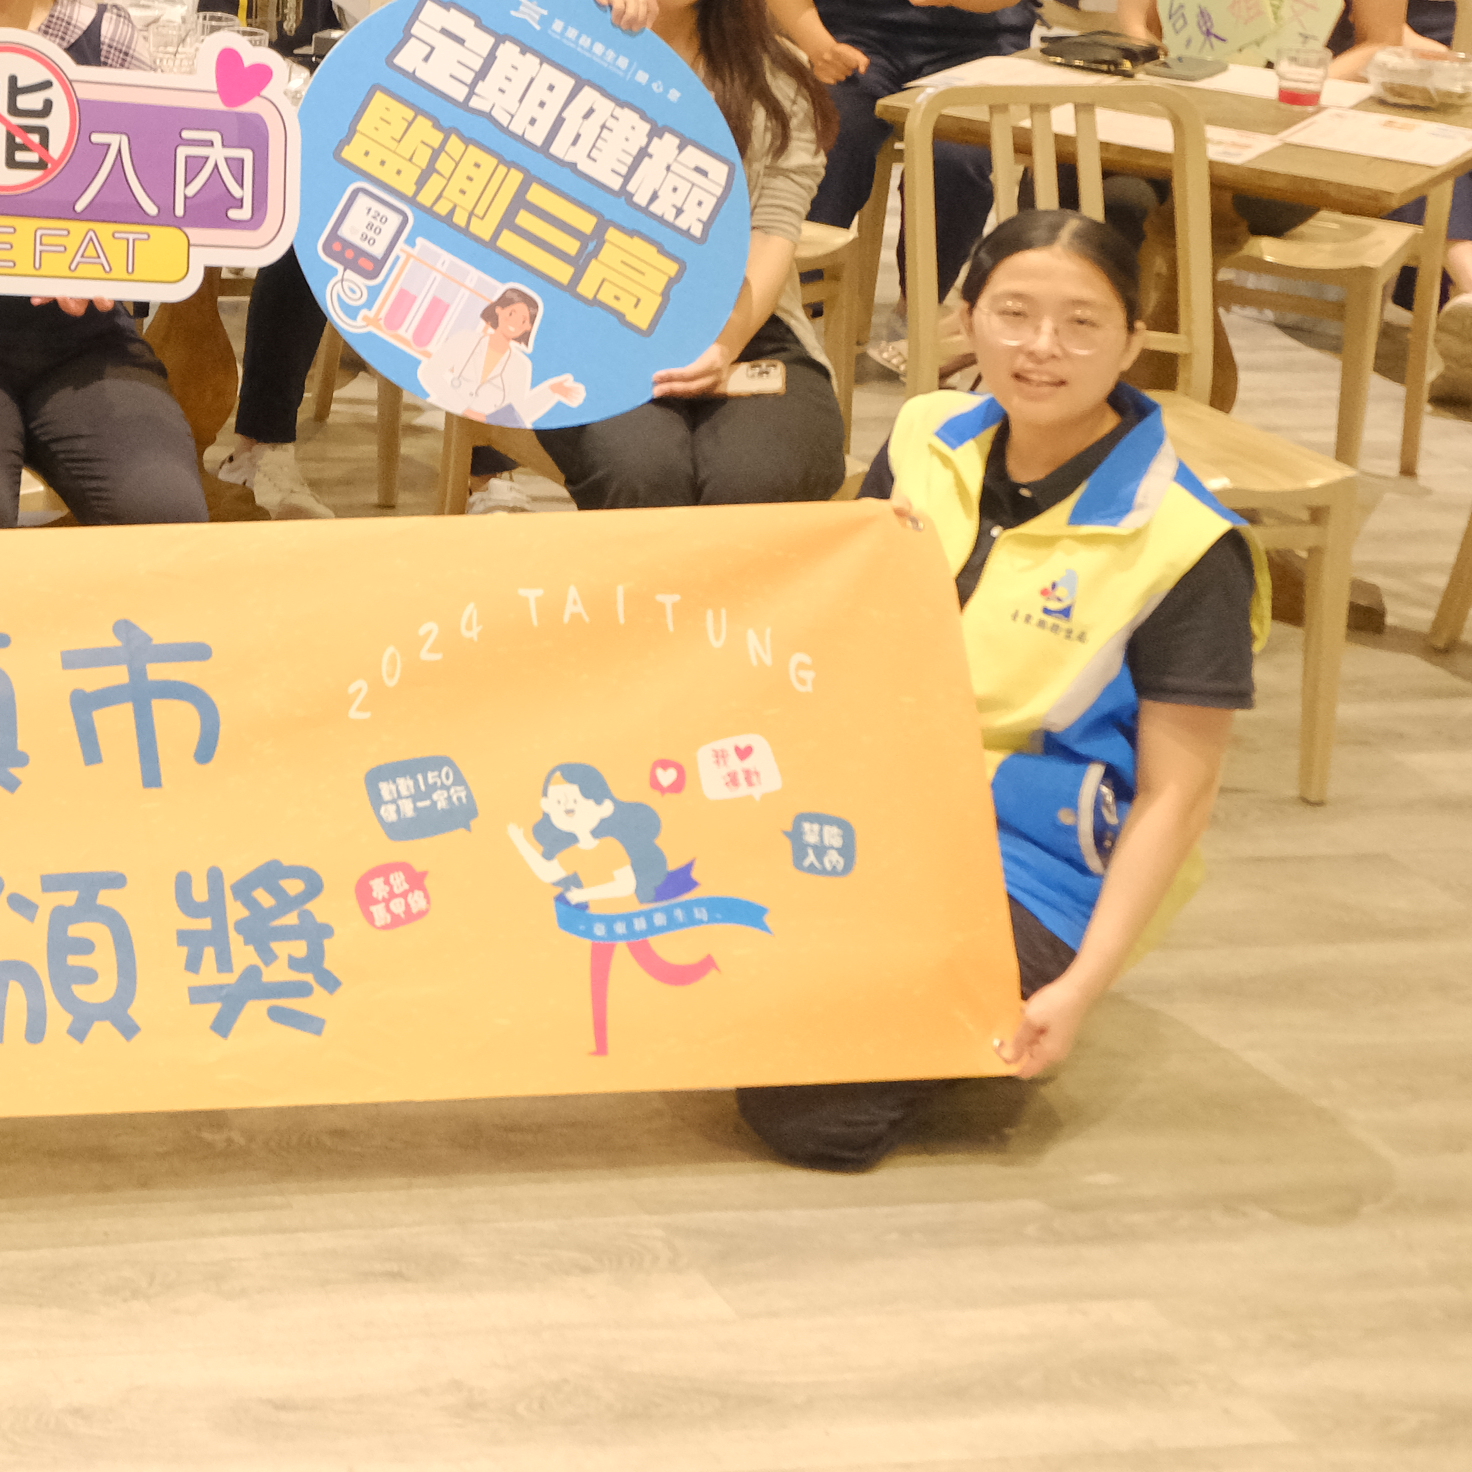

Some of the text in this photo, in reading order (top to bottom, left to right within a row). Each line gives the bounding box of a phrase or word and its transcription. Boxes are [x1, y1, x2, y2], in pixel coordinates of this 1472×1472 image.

[338, 91, 681, 332] 監測三高
[365, 206, 388, 225] 120
[359, 232, 376, 247] 90
[365, 221, 382, 236] 80
[33, 227, 151, 275] FAT
[347, 584, 817, 721] 2024 TAITUNG
